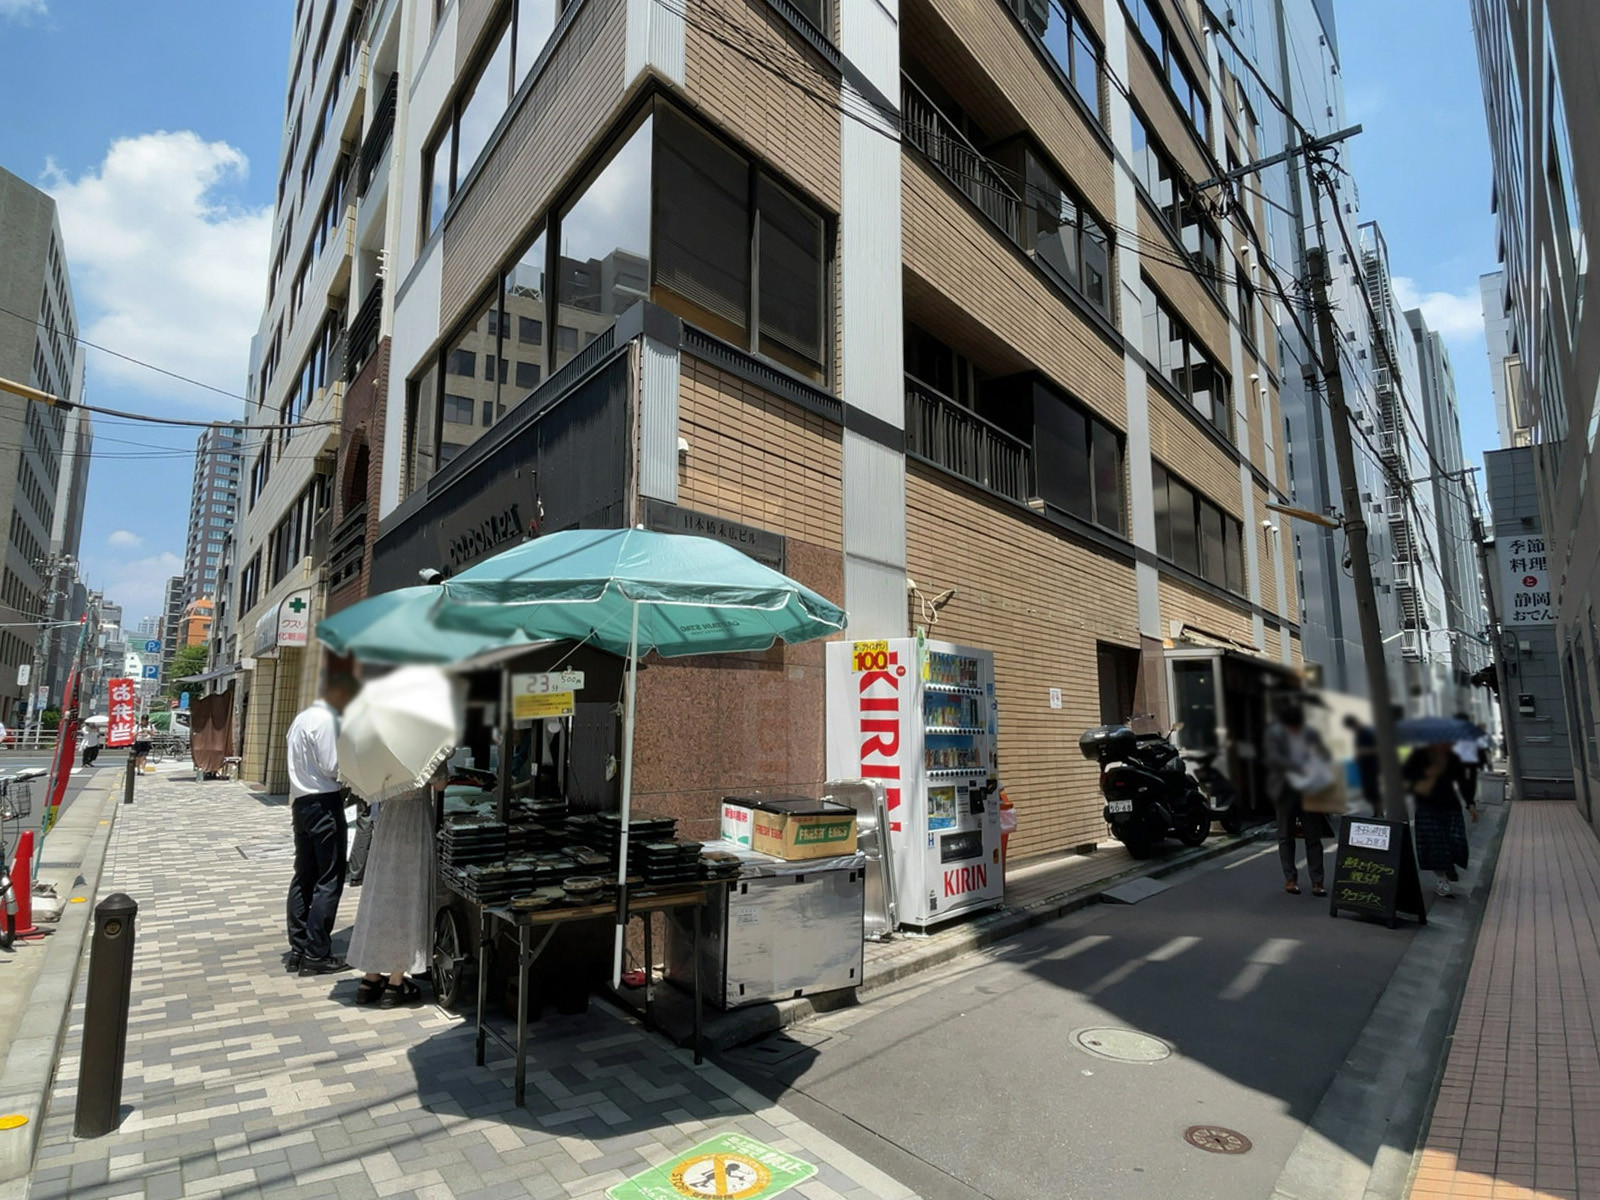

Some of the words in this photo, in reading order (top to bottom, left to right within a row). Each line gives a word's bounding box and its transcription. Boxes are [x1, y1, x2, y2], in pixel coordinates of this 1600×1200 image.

[1509, 539, 1545, 554] 季節
[1510, 557, 1548, 572] 料理
[1515, 592, 1550, 607] 静岡
[1513, 609, 1553, 621] おでん
[282, 620, 307, 629] クスリ
[854, 651, 888, 671] 100
[943, 863, 988, 898] KIRIN
